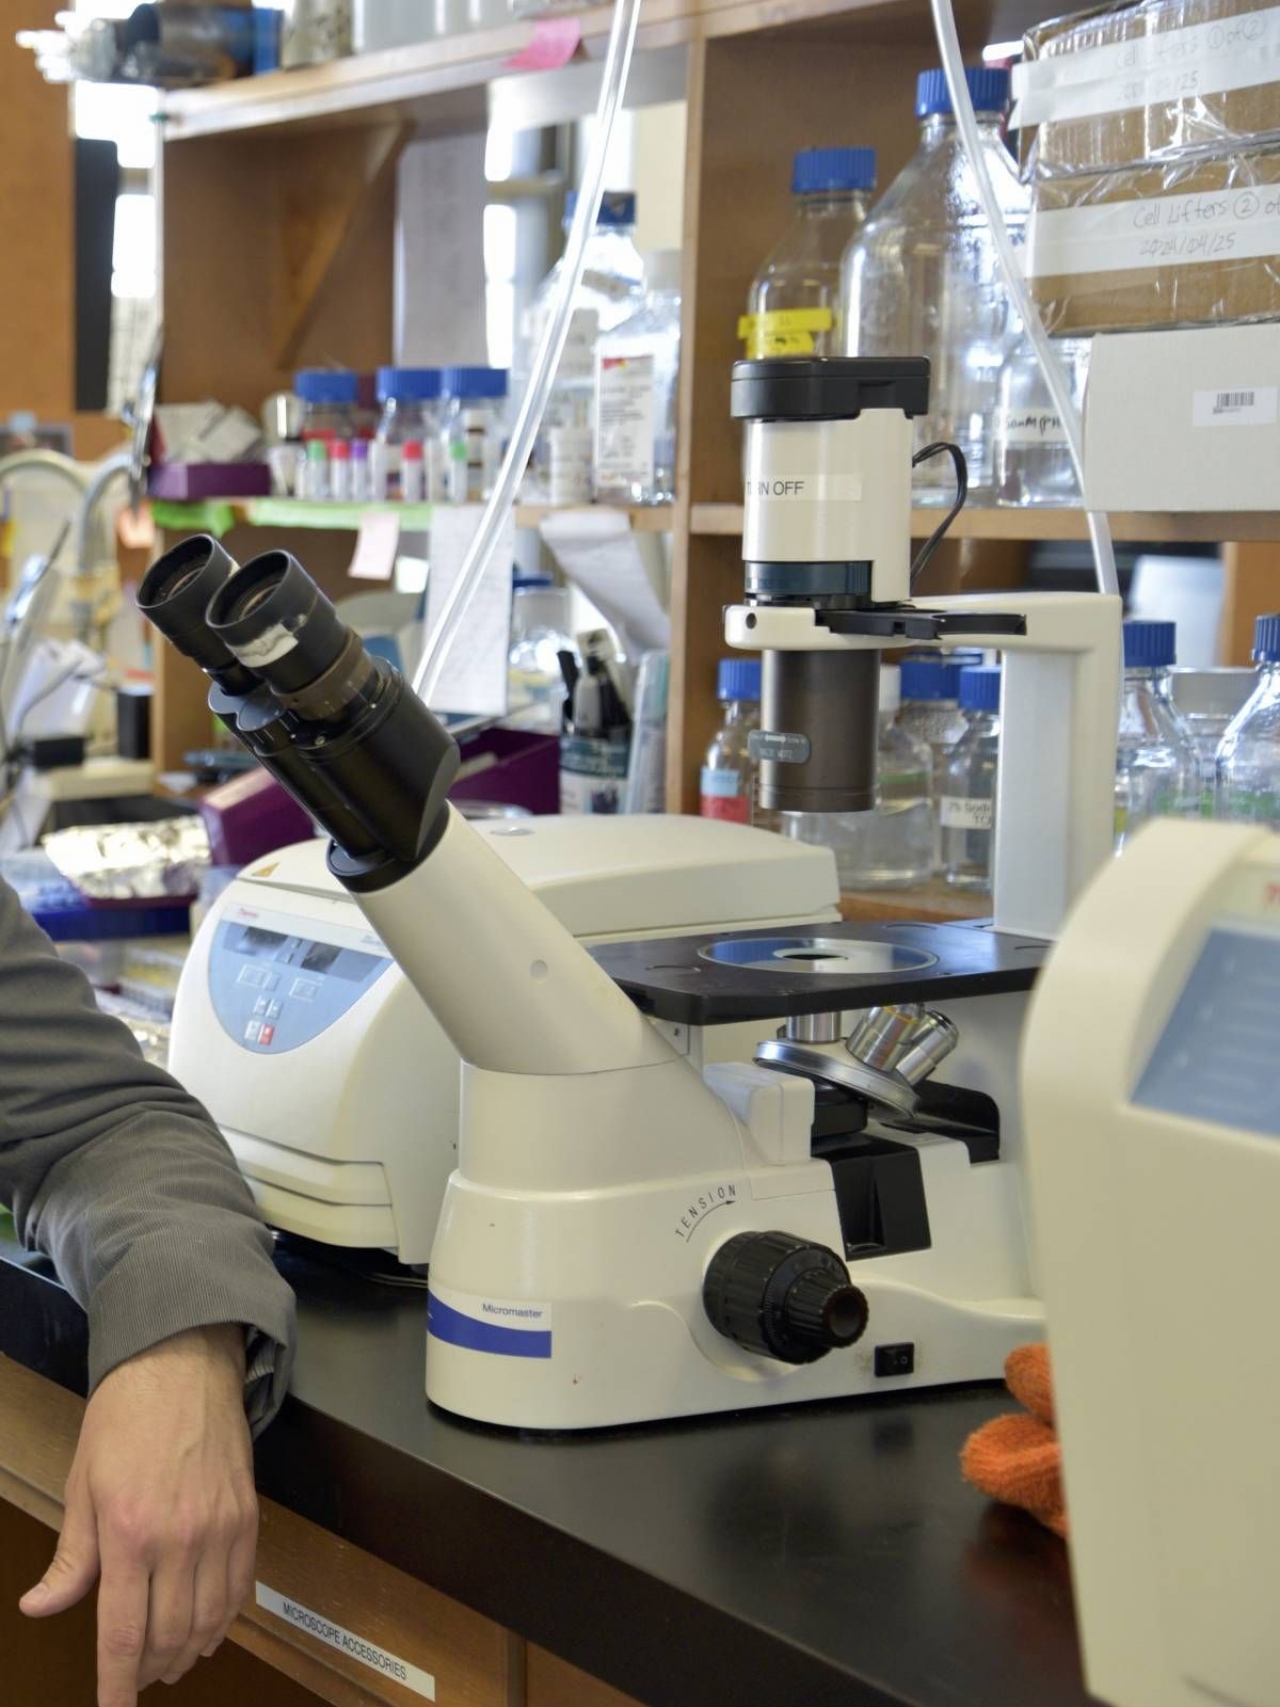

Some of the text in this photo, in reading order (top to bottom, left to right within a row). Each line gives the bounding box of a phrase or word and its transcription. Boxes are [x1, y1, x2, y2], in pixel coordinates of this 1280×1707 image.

[1133, 203, 1160, 228] Cell
[1167, 199, 1228, 225] Lifters
[773, 481, 805, 496] OFF
[675, 1185, 736, 1238] TENSION
[482, 1303, 543, 1319] Micromaster
[282, 1600, 407, 1681] MICROSCOPE ACCESSORIES
